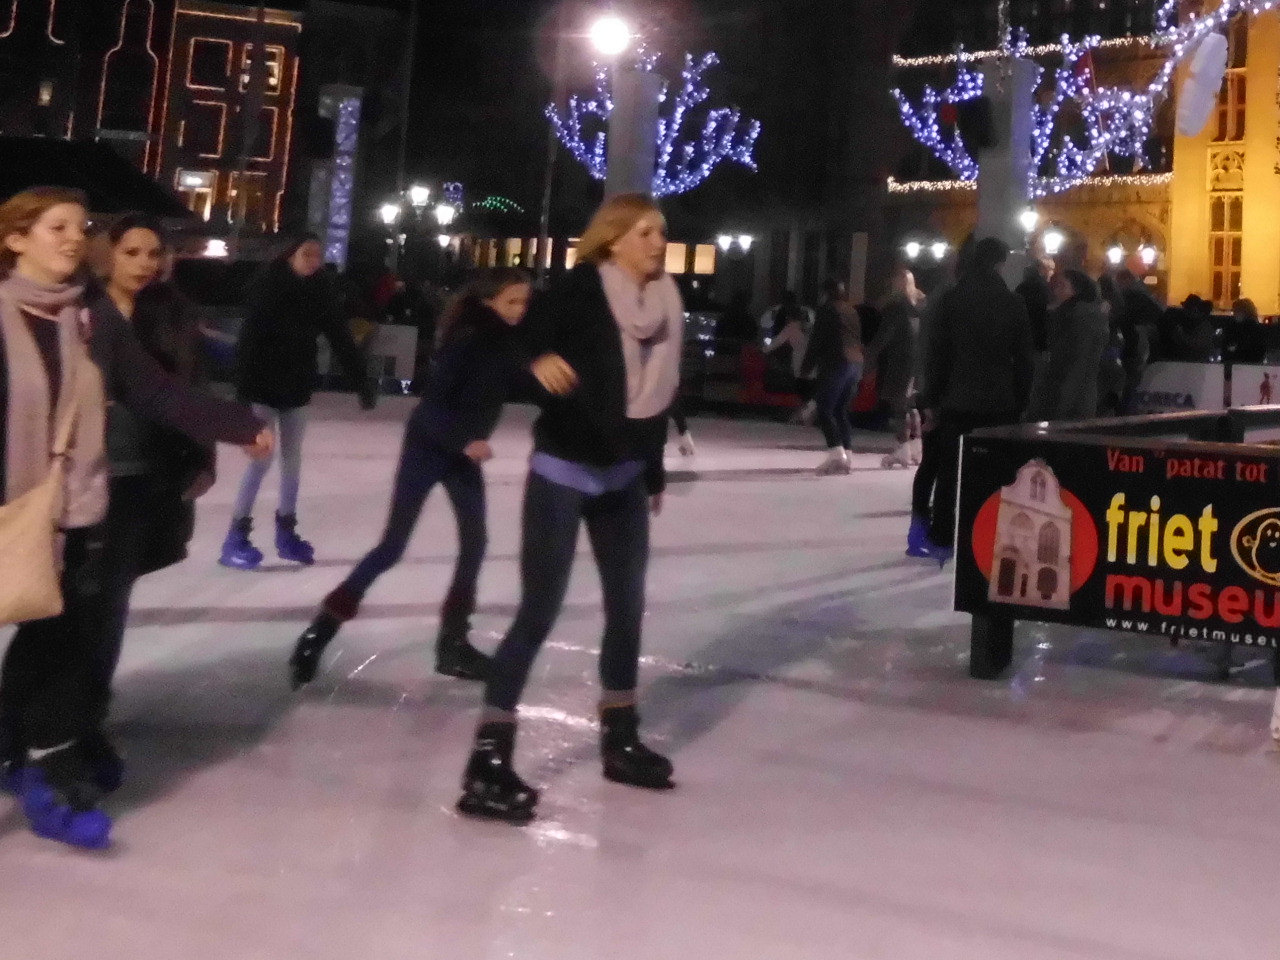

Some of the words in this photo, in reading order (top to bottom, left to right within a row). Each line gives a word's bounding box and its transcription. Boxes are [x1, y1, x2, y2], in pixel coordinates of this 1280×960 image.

[1107, 449, 1145, 473] Van
[1235, 461, 1268, 483] tot
[1106, 492, 1218, 573] friet
